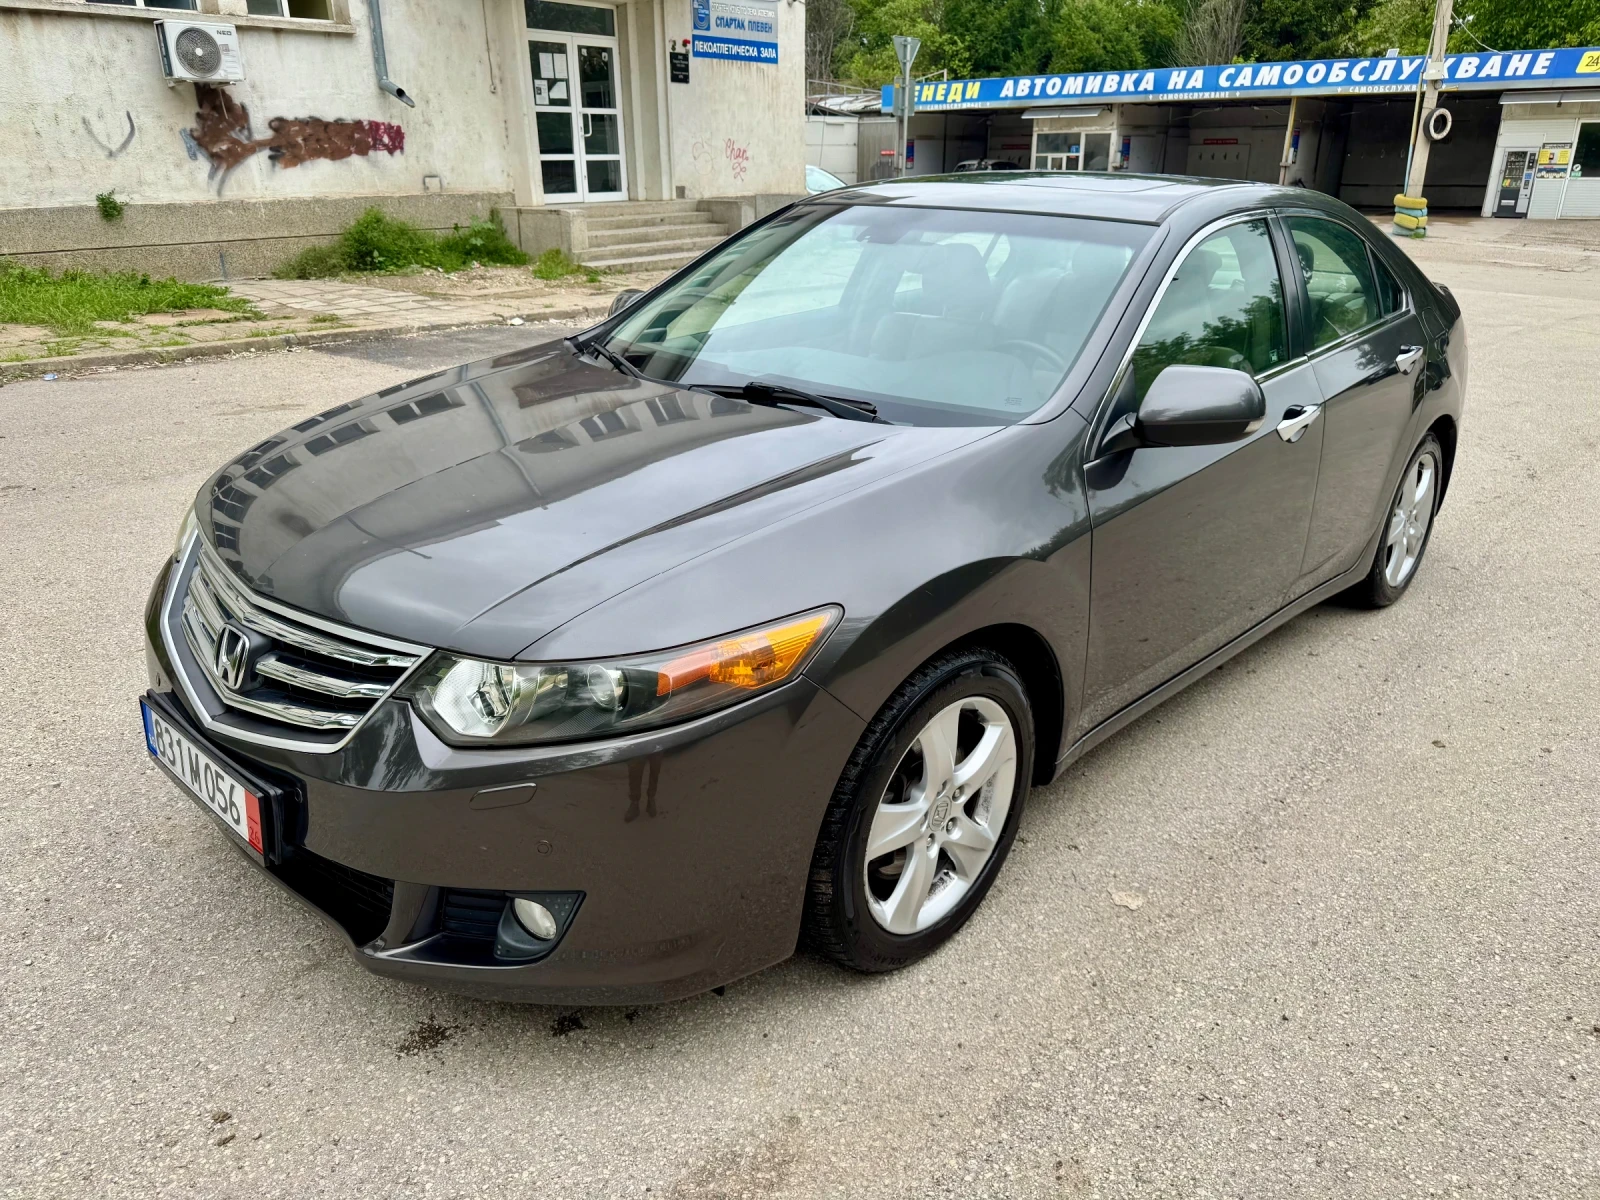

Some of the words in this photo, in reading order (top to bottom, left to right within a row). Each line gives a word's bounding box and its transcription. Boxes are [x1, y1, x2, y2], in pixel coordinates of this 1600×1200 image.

[715, 15, 746, 31] СПАРТАК
[747, 20, 773, 34] ПЛЕВЕН
[694, 40, 758, 57] ЛЕКОАТЛЕТИЧЕСКА
[760, 47, 777, 59] ЗАЛА
[999, 72, 1155, 98] АВТОМИВКА
[1167, 69, 1204, 90] НА
[1159, 91, 1230, 100] САМООБСЛУЖВАНЕ
